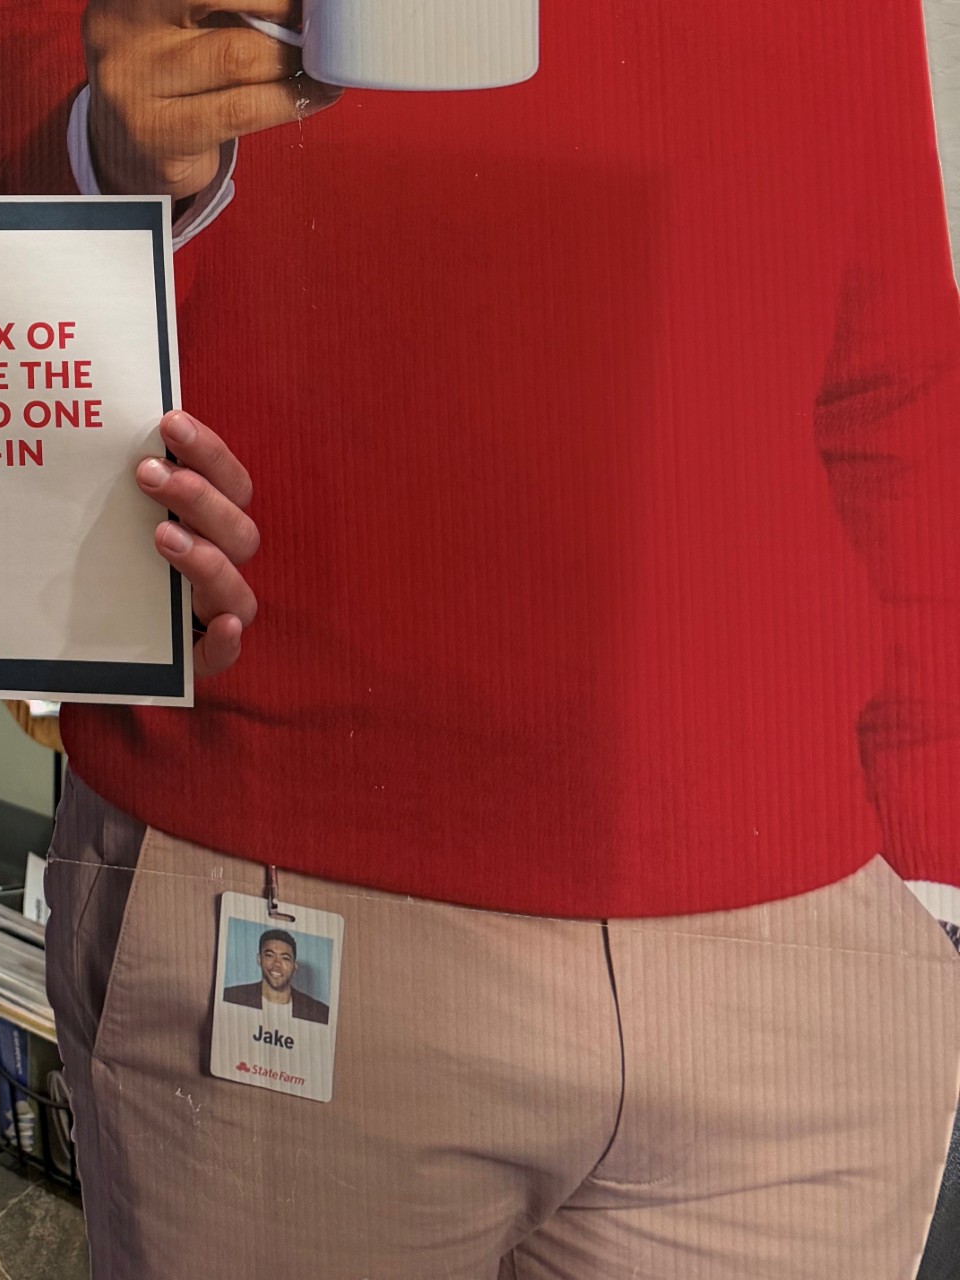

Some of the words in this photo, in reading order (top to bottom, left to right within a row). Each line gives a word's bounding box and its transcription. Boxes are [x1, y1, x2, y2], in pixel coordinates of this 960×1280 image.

[26, 321, 76, 351] OF
[20, 359, 93, 390] THE
[22, 399, 103, 429] ONE
[253, 1025, 295, 1050] Jake
